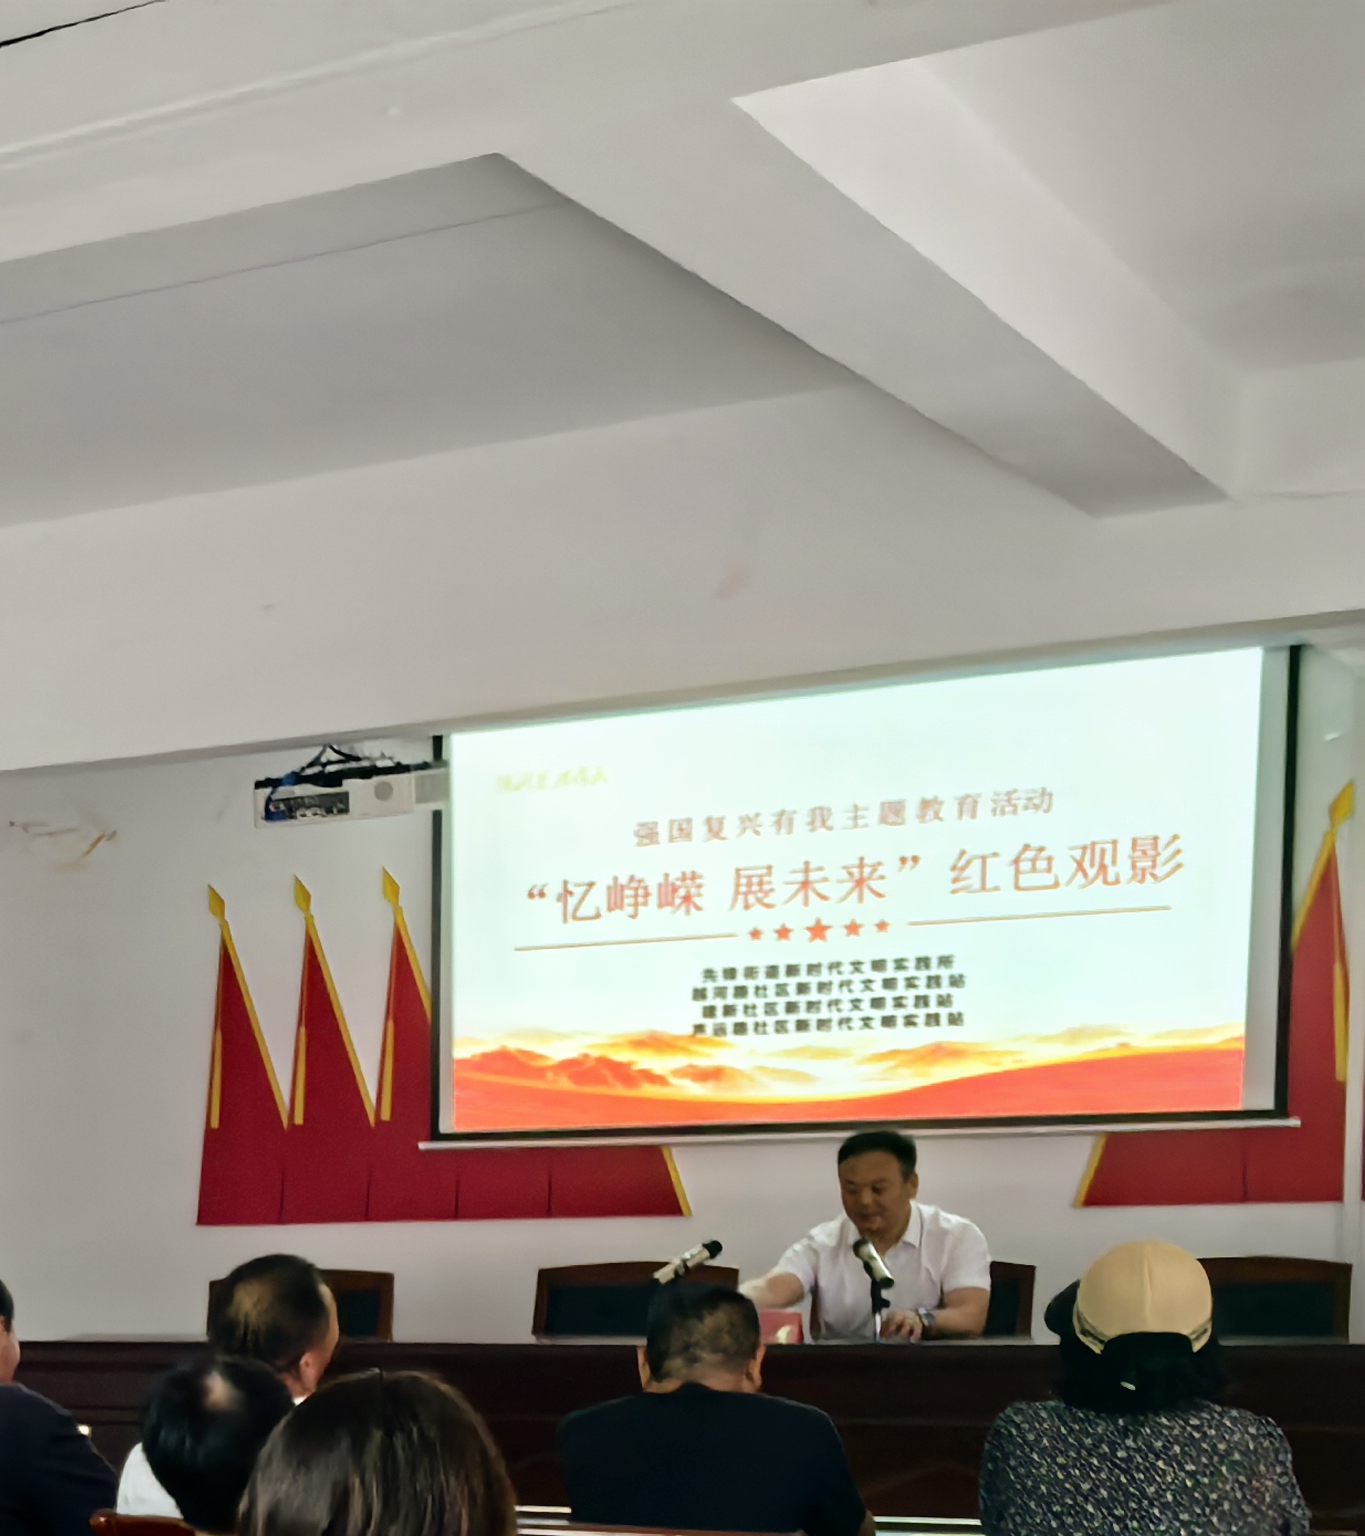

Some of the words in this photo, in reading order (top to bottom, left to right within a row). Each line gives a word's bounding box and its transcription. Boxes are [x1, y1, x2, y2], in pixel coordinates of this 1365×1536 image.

[633, 786, 1054, 847] 强国复兴有我主题教育活动
